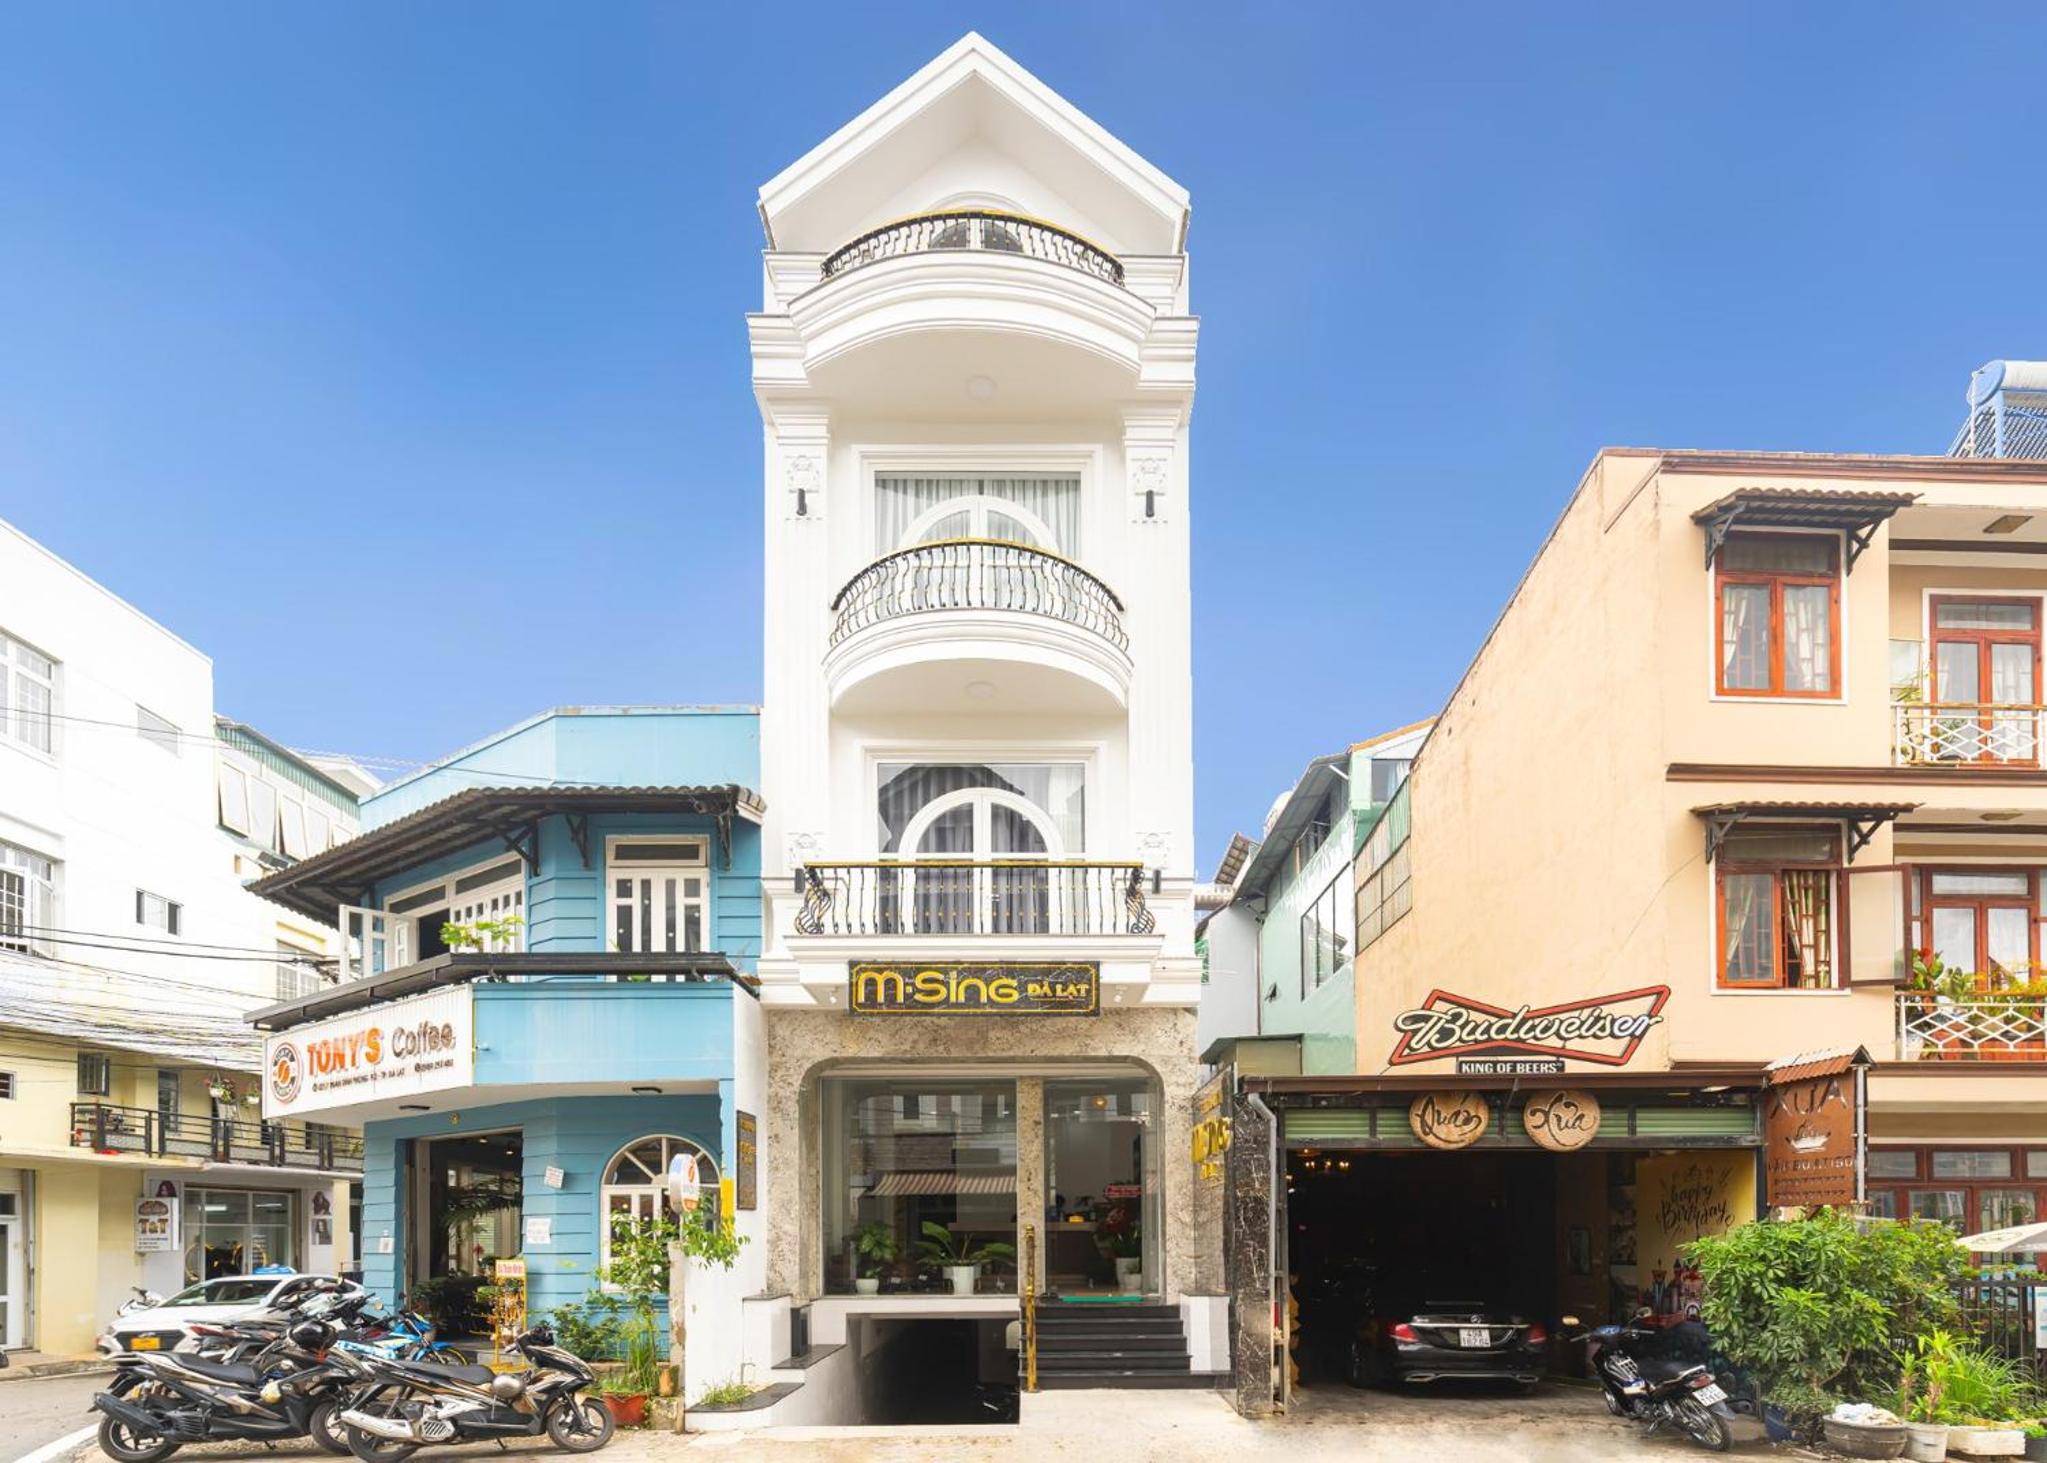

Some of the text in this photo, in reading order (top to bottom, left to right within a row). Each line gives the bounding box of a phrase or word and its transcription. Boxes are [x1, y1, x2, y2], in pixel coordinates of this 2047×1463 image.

[307, 1027, 384, 1077] TONY'S
[392, 1020, 457, 1059] Coffee
[1395, 1005, 1663, 1051] Budweiser
[1462, 1062, 1494, 1074] KING
[1496, 1062, 1514, 1074] OF
